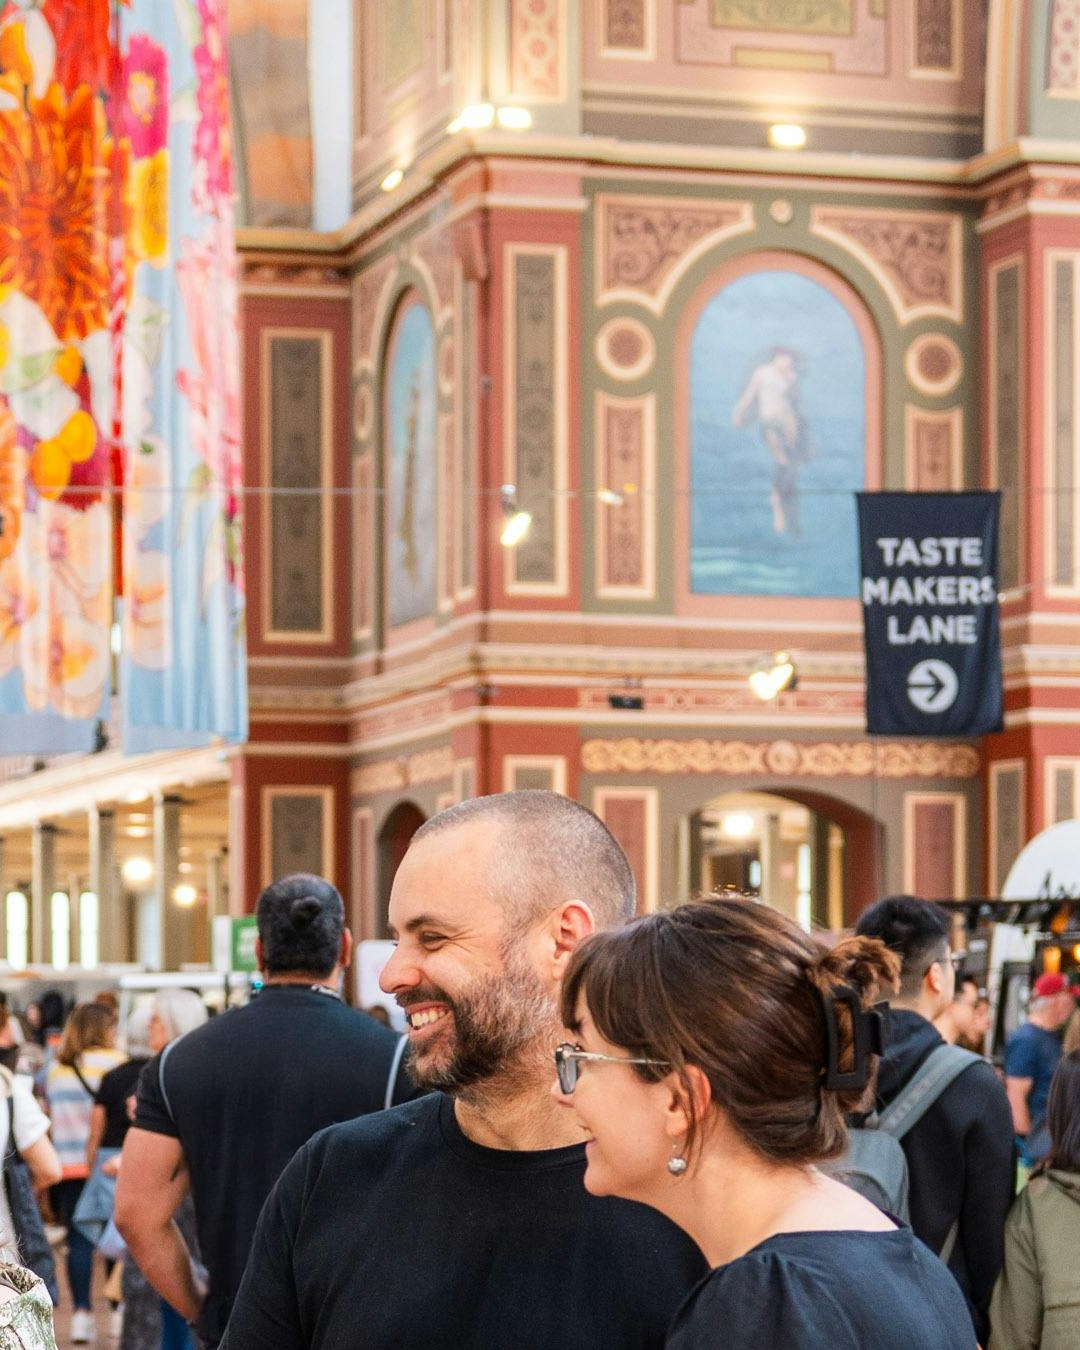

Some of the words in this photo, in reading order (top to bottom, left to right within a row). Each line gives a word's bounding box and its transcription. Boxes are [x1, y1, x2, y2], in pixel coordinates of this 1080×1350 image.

[877, 537, 983, 566] TASTE
[862, 575, 996, 605] MAKERS
[887, 615, 978, 645] LANE
